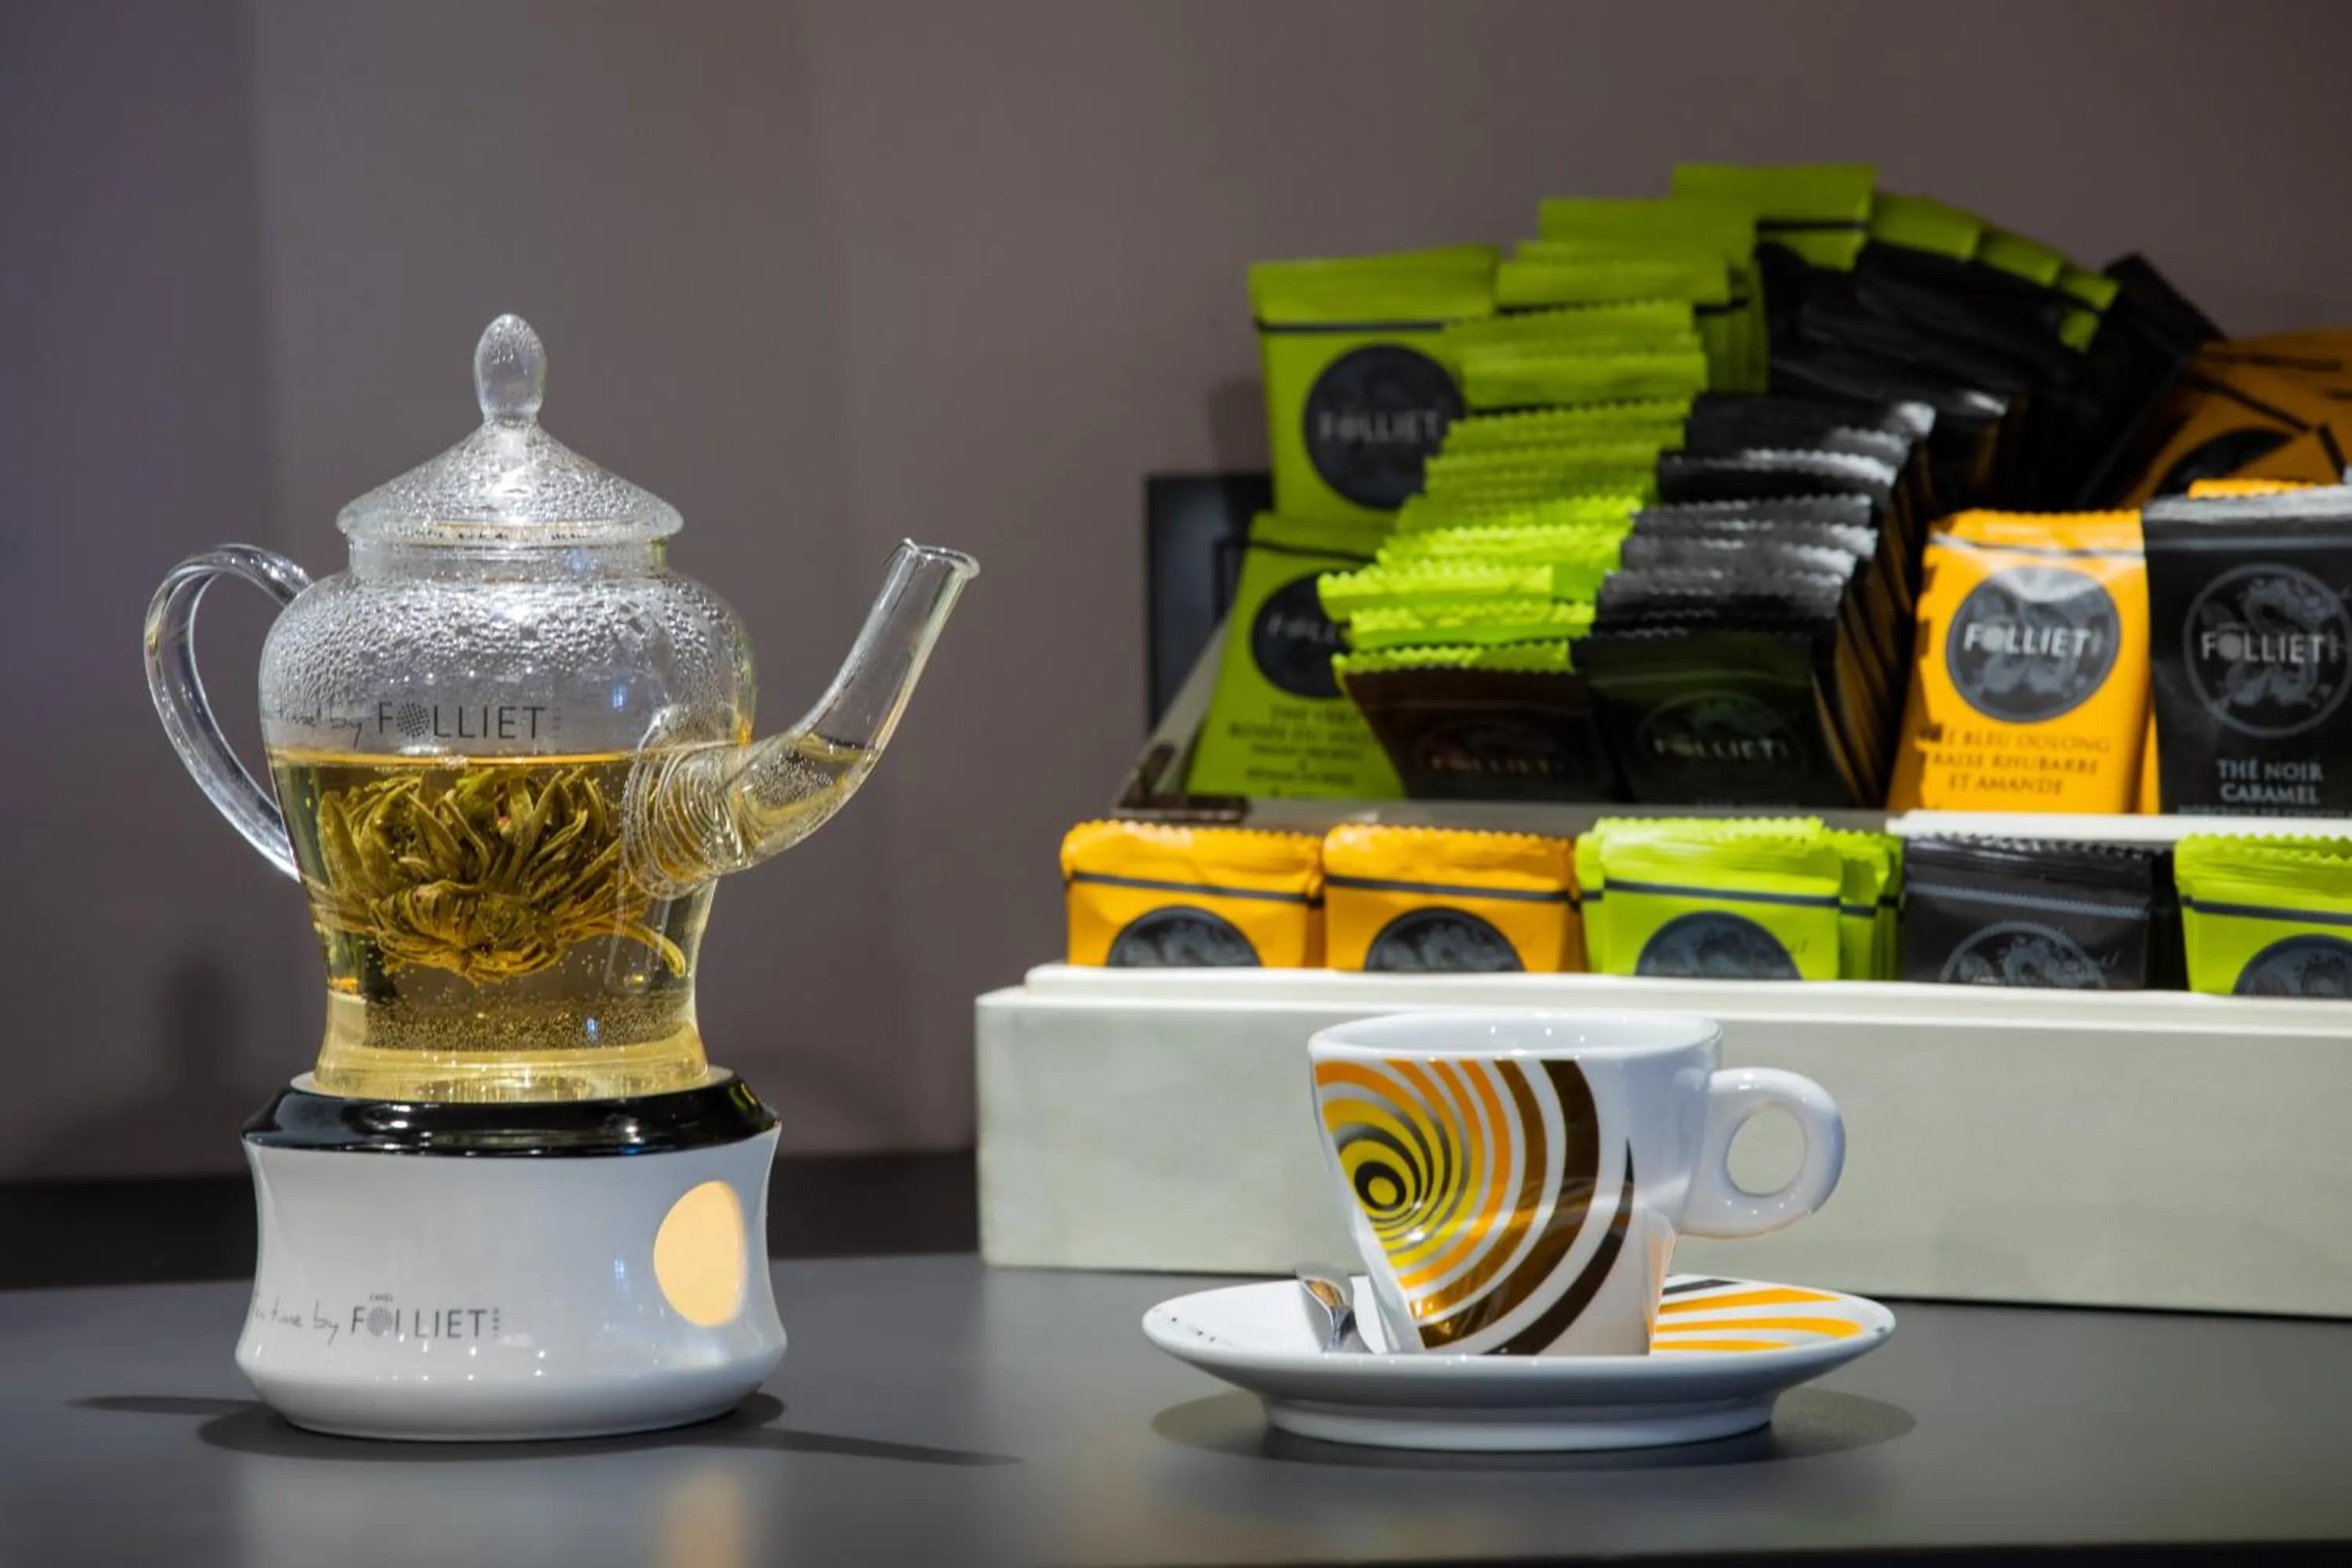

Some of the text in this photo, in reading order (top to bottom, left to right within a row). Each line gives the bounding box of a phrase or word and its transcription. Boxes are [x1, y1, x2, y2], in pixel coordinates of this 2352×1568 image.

[1963, 622, 2090, 658] FOLLIET
[2201, 630, 2326, 664] FOLLIET
[378, 701, 549, 740] FOLLIET
[1947, 773, 2063, 796] ET AMANDE
[2264, 760, 2325, 782] NOIR
[2220, 782, 2321, 805] CARAMEL
[313, 1298, 339, 1347] by
[350, 1305, 488, 1339] FOLLIET
